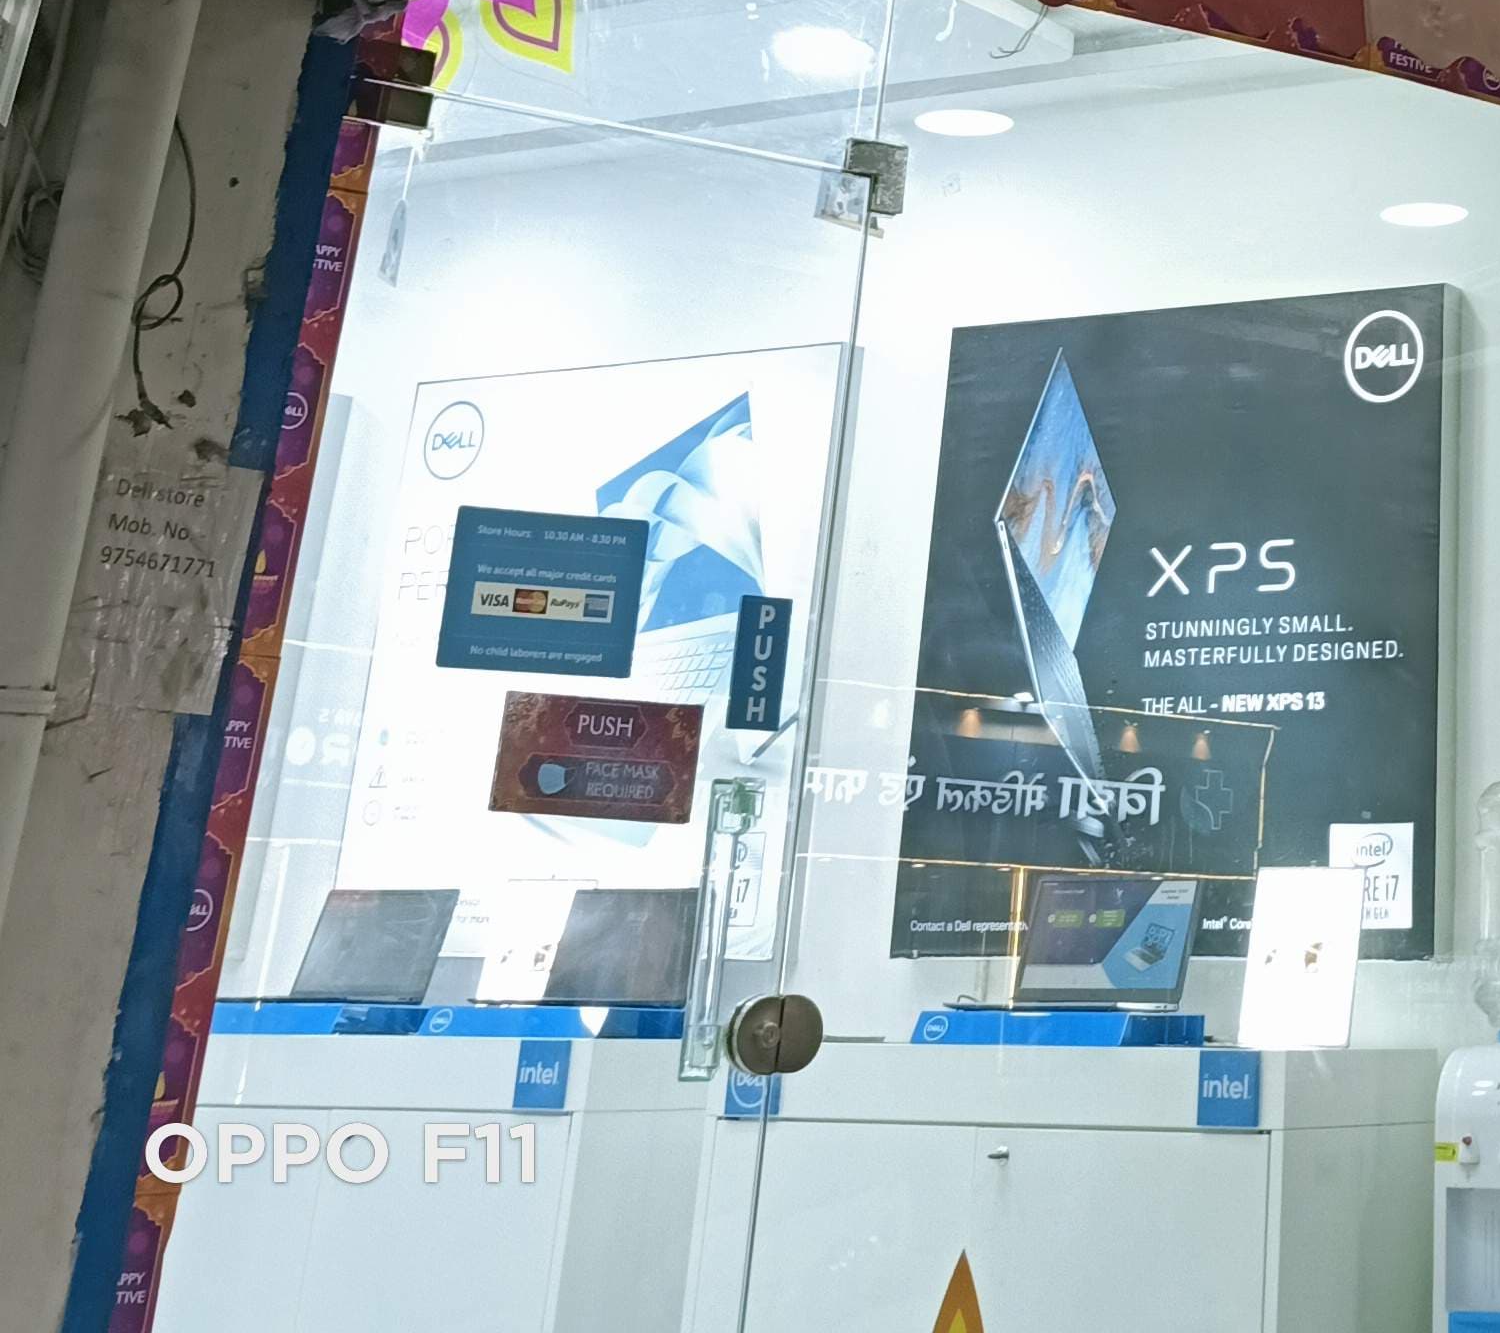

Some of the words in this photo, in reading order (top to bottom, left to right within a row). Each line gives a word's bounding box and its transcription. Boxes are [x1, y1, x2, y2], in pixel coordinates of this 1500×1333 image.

[1354, 343, 1416, 370] DELL
[431, 430, 476, 452] DELL
[157, 489, 205, 509] store
[101, 545, 216, 578] 9754671771
[1146, 538, 1298, 597] XPS
[494, 566, 524, 578] accept
[525, 567, 537, 577] all
[538, 569, 565, 581] major
[566, 571, 592, 582] credit
[593, 573, 617, 583] cards
[480, 593, 509, 608] VISA
[1145, 617, 1274, 641] STUNNINGLY
[1278, 614, 1353, 634] SMALL.
[469, 644, 484, 654] No
[486, 646, 508, 656] child
[548, 651, 563, 660] are
[564, 650, 602, 663] engaged
[746, 603, 776, 724] PUSH
[1144, 644, 1288, 668] MASTERFULLY
[1292, 639, 1404, 663] DESIGNED.
[1141, 697, 1175, 715] THE
[1176, 695, 1207, 714] ALL
[1221, 694, 1265, 713] NEW
[1266, 692, 1304, 711] XPS
[1305, 691, 1326, 710] 13
[577, 714, 634, 737] PUSH
[585, 761, 621, 777] FACE
[623, 764, 660, 780] MASK
[585, 783, 654, 799] REQUIRED
[1385, 875, 1400, 901] i7
[910, 919, 945, 932] Contact
[946, 921, 953, 931] a
[954, 919, 972, 932] Dell
